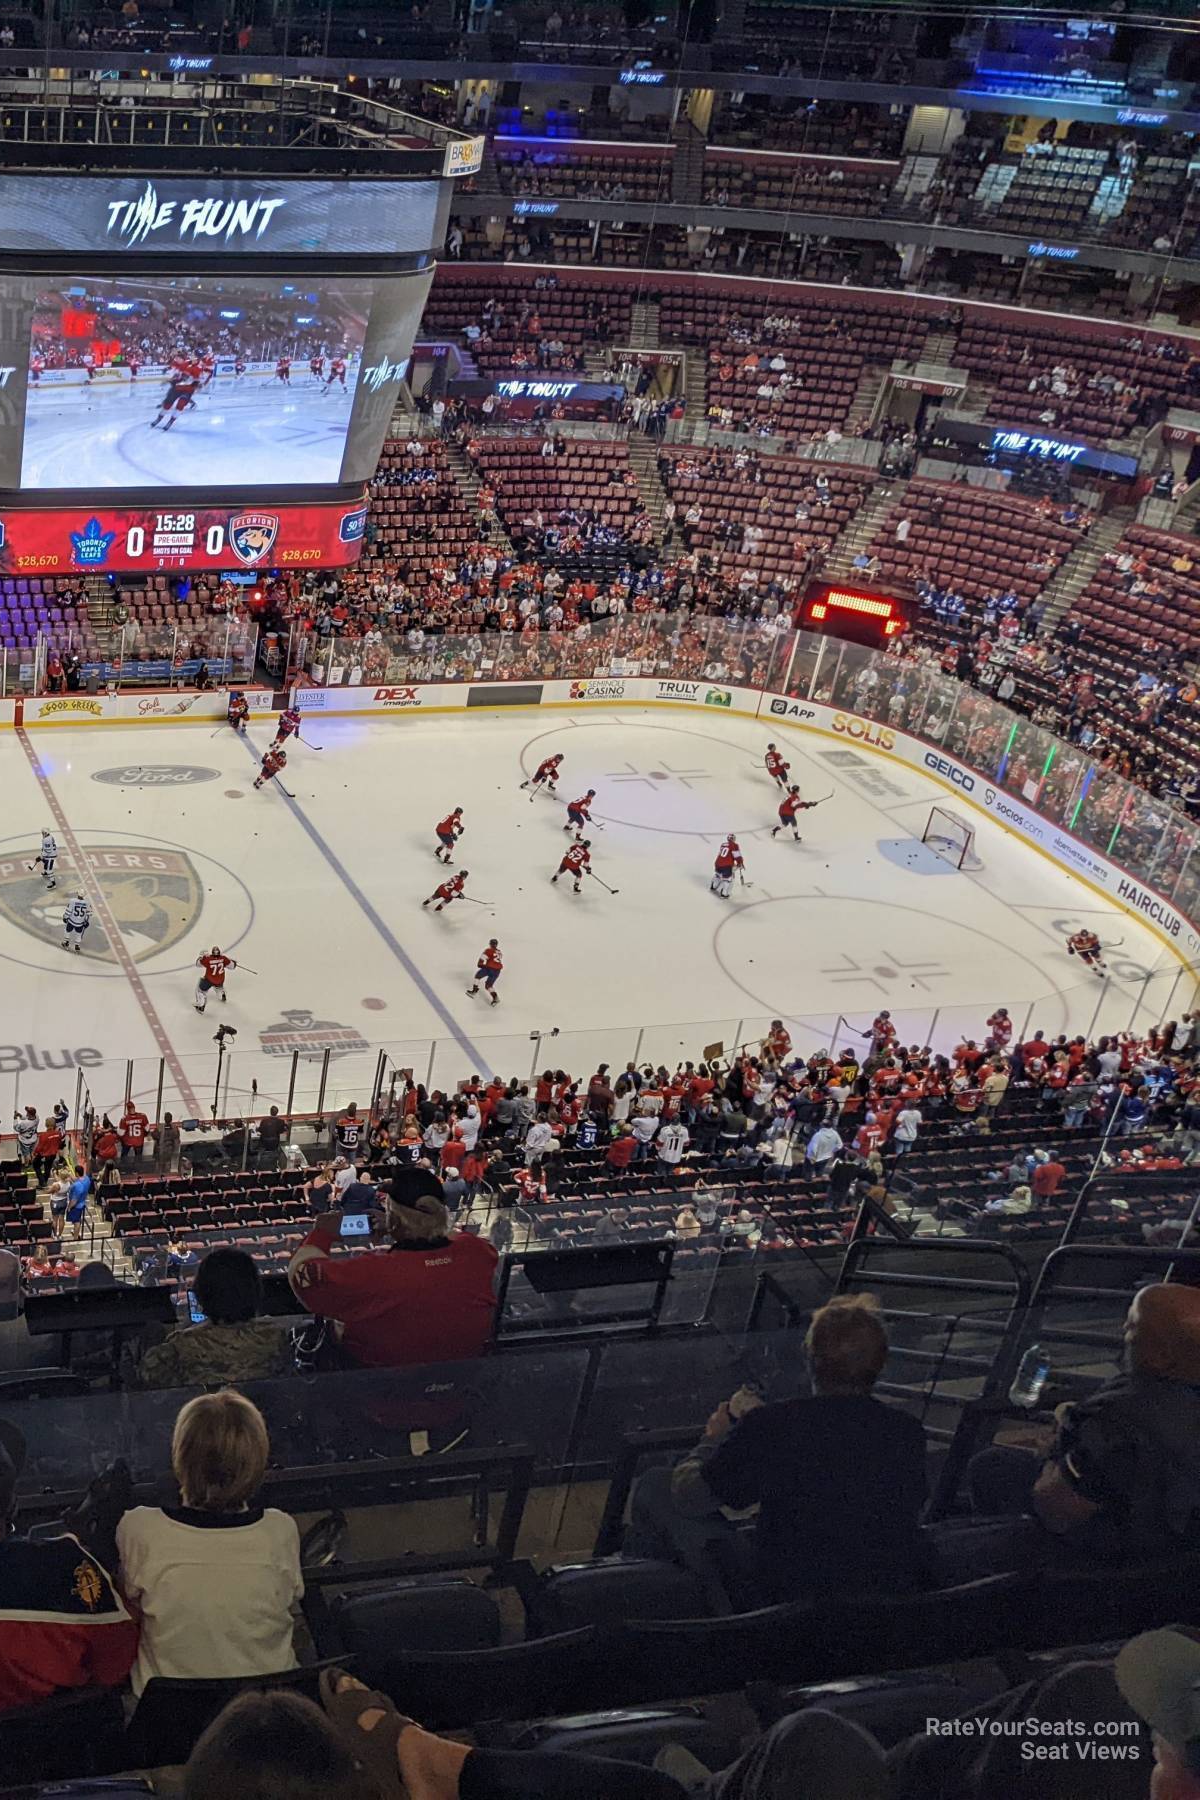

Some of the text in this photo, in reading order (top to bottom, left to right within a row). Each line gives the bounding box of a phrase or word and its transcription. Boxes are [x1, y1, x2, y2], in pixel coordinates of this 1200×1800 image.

[432, 347, 446, 357] 104
[659, 355, 673, 364] 105
[942, 386, 959, 397] 107
[1170, 429, 1188, 440] 107
[155, 514, 194, 532] 15:28
[234, 516, 272, 527] FLORIDA
[346, 521, 358, 532] 50
[77, 538, 107, 550] TORONTO
[126, 526, 144, 557] 0
[157, 535, 190, 545] PRE-GAME
[205, 525, 224, 555] 0
[179, 546, 192, 554] GOAL
[282, 549, 321, 561] $28,670
[18, 555, 58, 567] $28,670
[588, 680, 625, 688] SEMINOLE
[658, 682, 699, 694] TRULY
[374, 687, 418, 701] DEX
[587, 687, 625, 695] CASINO
[46, 699, 97, 712] GOOD GREEK
[832, 713, 897, 750] SOLIS
[767, 758, 776, 768] 15
[120, 766, 194, 783] Ford
[924, 752, 975, 792] GEICO
[73, 905, 87, 917] 55
[1117, 878, 1182, 937] HAIRCLUB
[209, 963, 224, 976] 72
[259, 1030, 362, 1044] DRIVE SOBER OR
[261, 1039, 370, 1054] GET PULLED OVER
[129, 1124, 141, 1136] 16
[343, 1130, 357, 1143] 16
[584, 1132, 596, 1143] 34
[669, 1137, 679, 1150] 11
[411, 1149, 420, 1161] 9
[425, 1257, 452, 1268] Reebok
